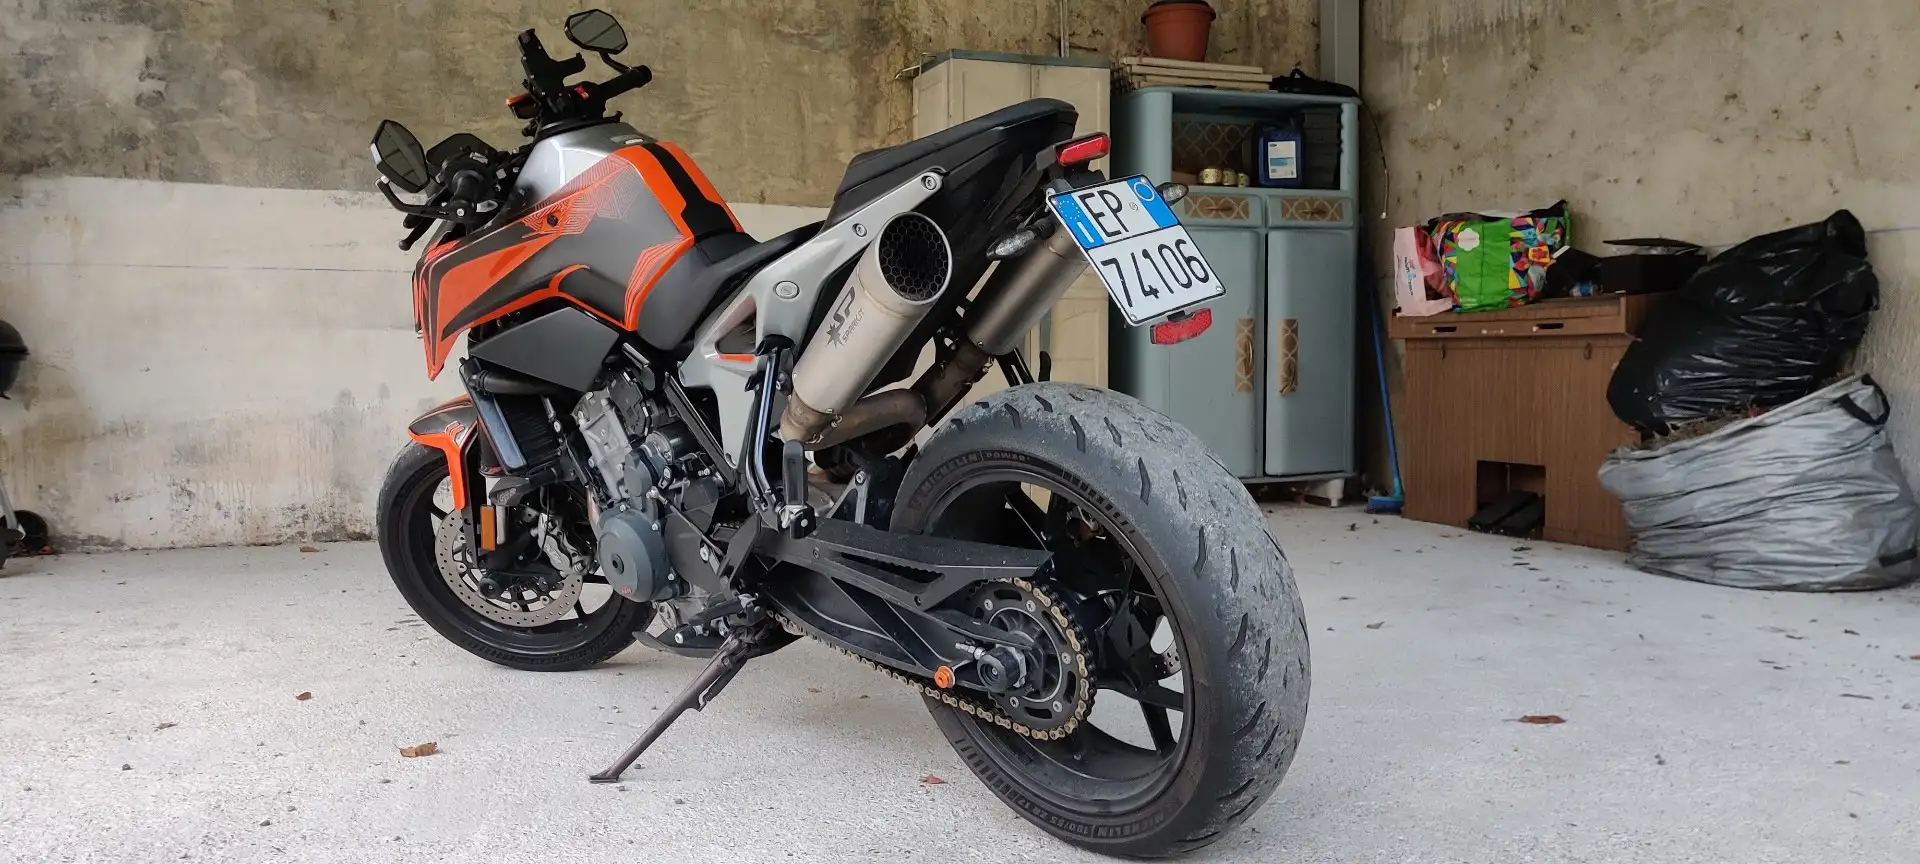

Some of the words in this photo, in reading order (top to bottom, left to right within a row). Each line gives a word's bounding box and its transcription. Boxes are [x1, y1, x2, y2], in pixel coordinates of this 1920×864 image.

[1078, 189, 1129, 238] EP
[1101, 239, 1210, 308] 74106
[921, 455, 978, 494] MICHELIN
[986, 452, 1027, 462] POWER
[1017, 799, 1031, 809] 17
[1032, 806, 1048, 818] ZR
[1097, 812, 1164, 837] MICHELIN
